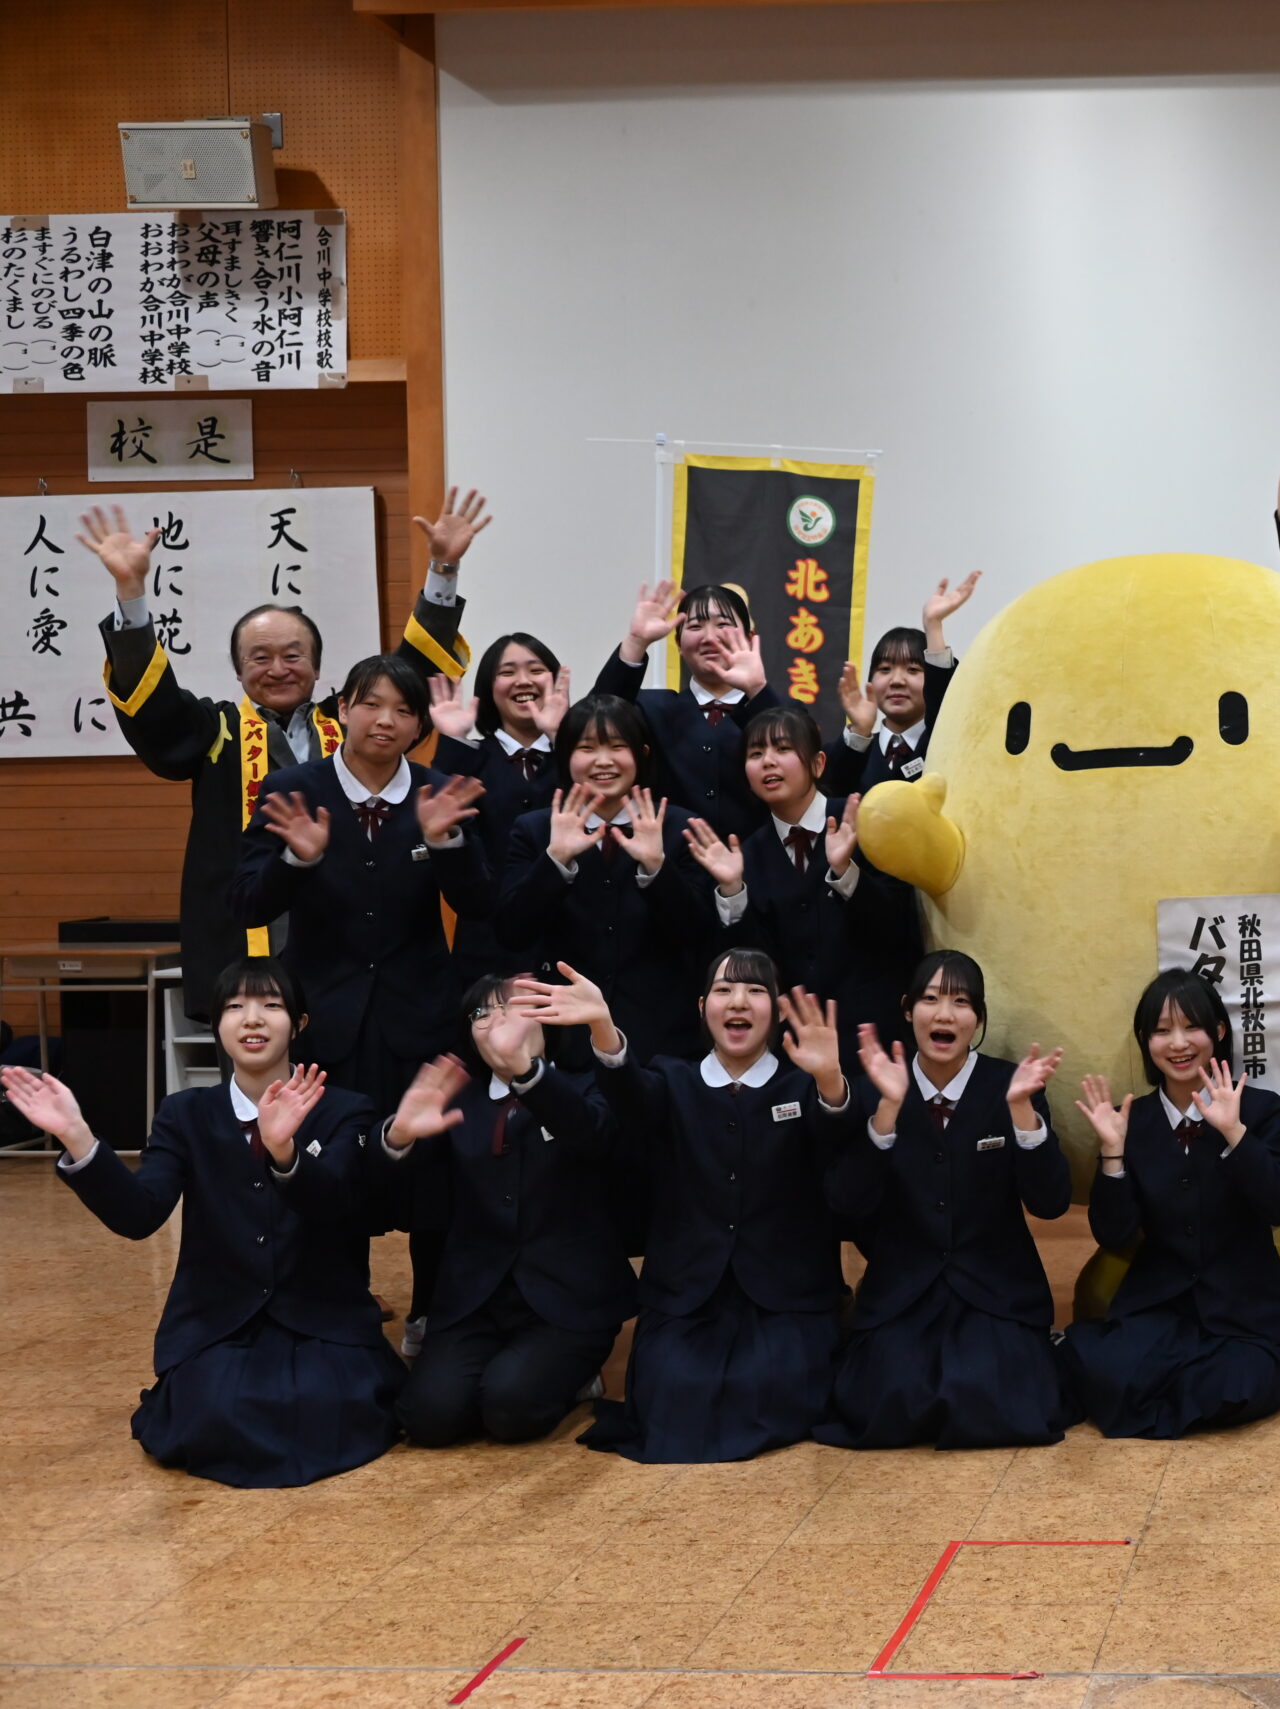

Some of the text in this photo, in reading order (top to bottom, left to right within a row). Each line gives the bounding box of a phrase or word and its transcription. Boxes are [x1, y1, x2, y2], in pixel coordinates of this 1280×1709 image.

[0, 227, 28, 329] 杉のたくまし
[31, 227, 58, 329] ますぐにのびる
[57, 226, 86, 381] うるわし四季の色
[85, 226, 118, 368] 白津の山の脈
[138, 223, 168, 384] おおわが合川中学校
[166, 222, 194, 376] おおわが合川中学校
[195, 221, 223, 314] 父母の声
[222, 220, 243, 323] 耳すましきく
[250, 219, 278, 382] 響き合う水の音
[274, 219, 304, 371] 阿仁川小阿仁川
[316, 226, 335, 369] 合川中学校校歌
[110, 416, 232, 465] 校是
[23, 513, 68, 657] 人に愛
[145, 511, 192, 655] 地に花
[267, 507, 309, 596] 天に
[785, 557, 830, 705] 北あき
[1188, 914, 1227, 985] バタ
[1237, 913, 1267, 1079] 秋田県北秋田市
